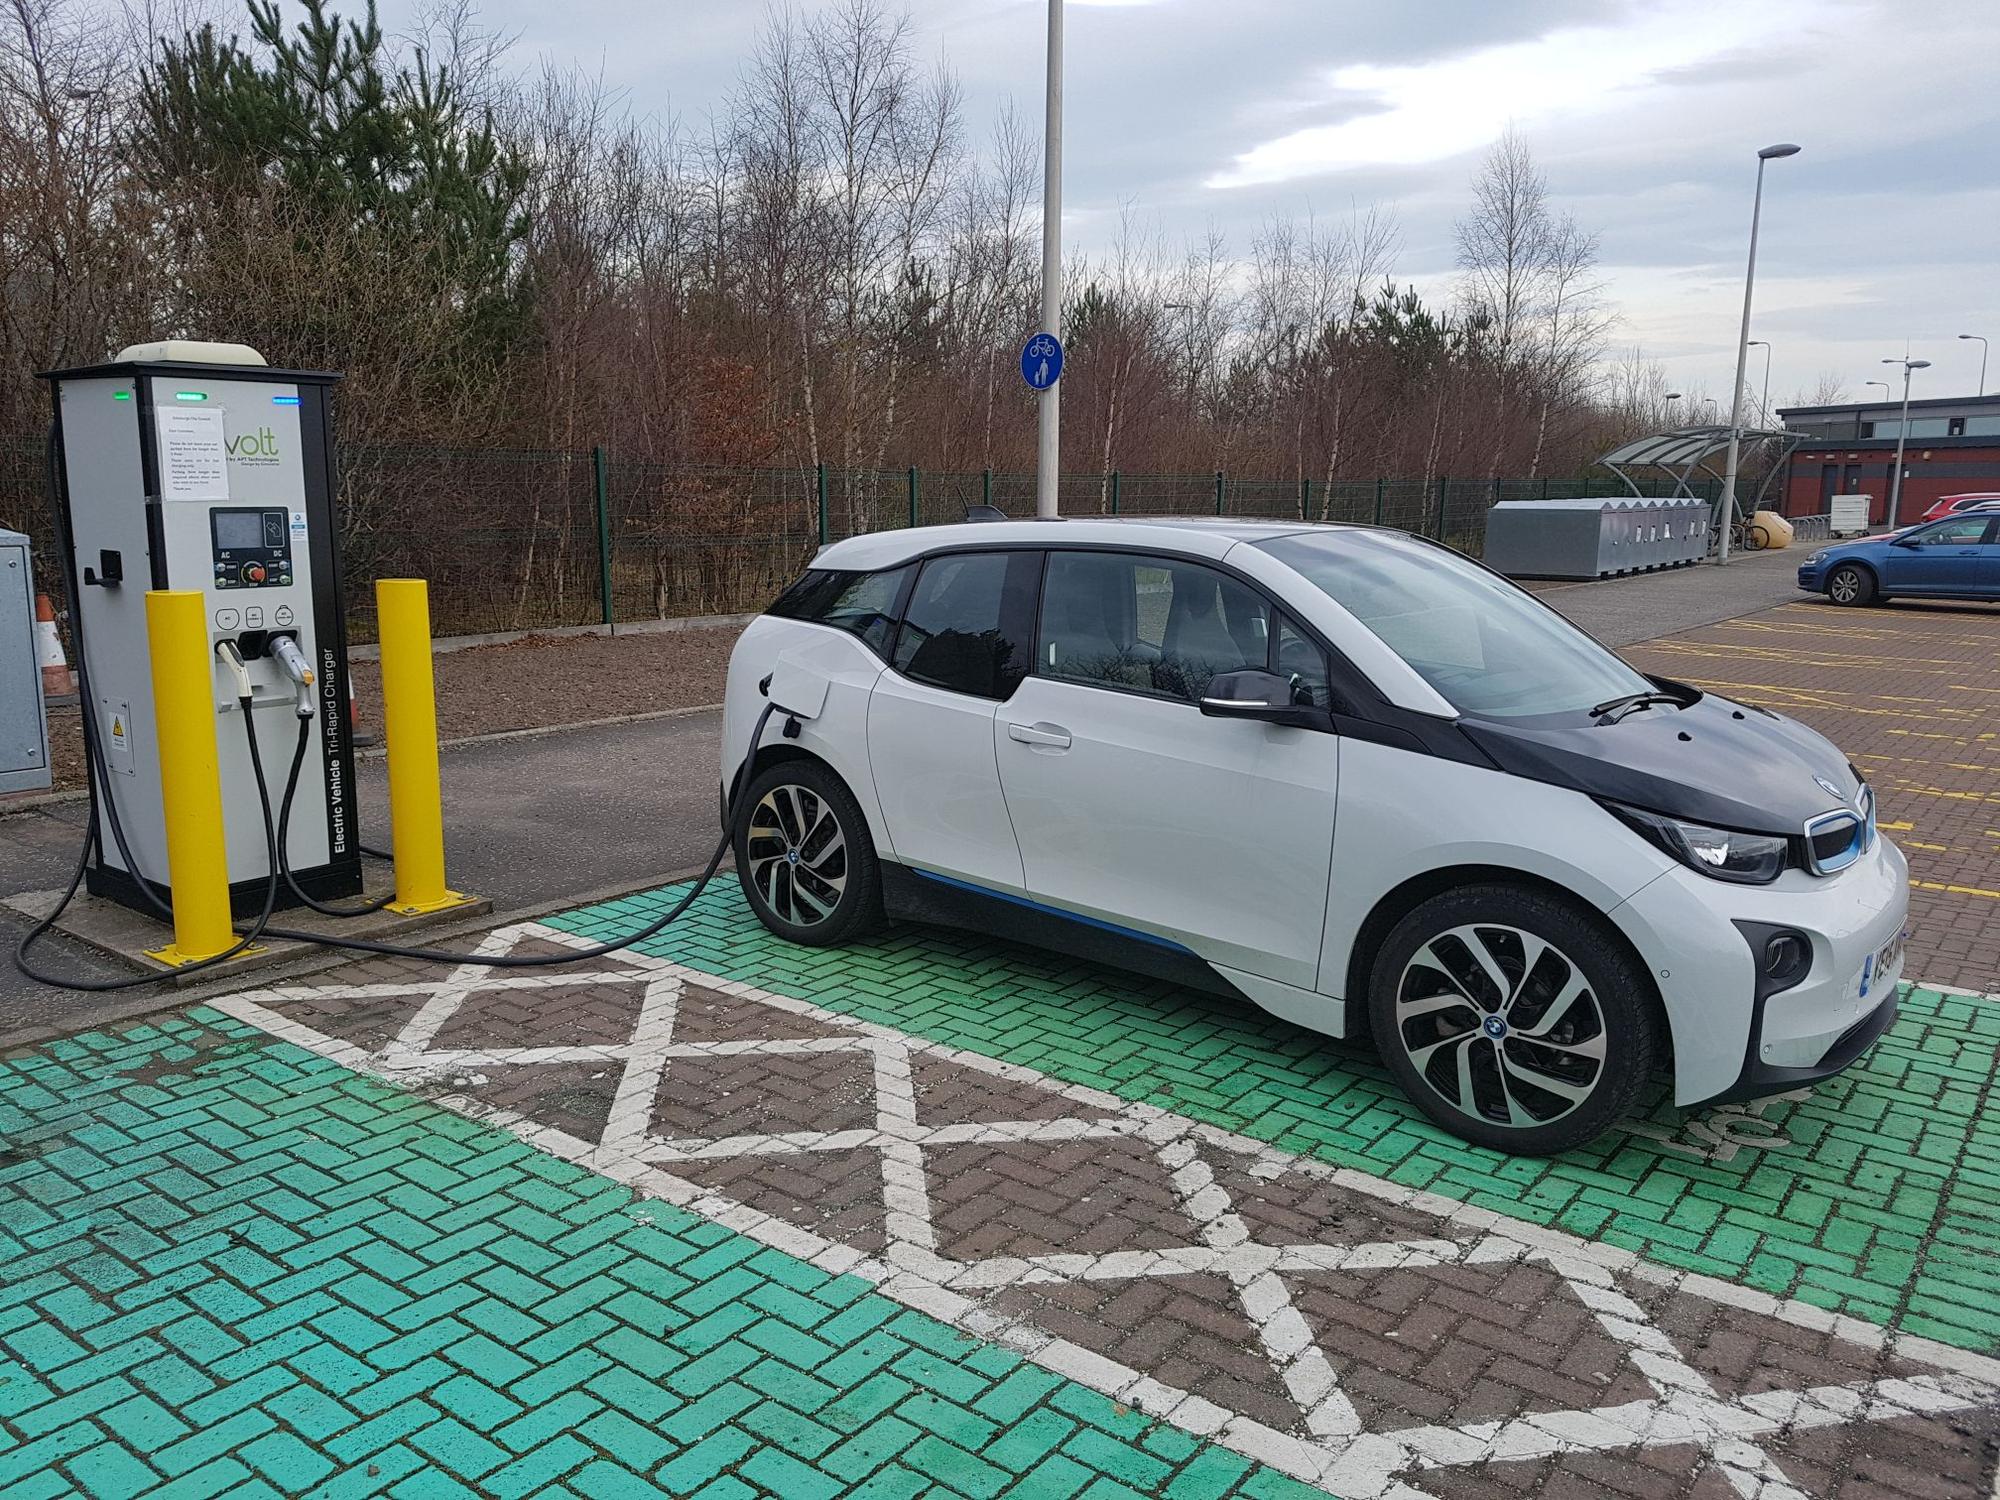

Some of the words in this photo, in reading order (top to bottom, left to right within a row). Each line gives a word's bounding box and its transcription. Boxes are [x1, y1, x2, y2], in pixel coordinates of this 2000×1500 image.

[221, 551, 231, 559] AC
[324, 648, 337, 698] Charger
[325, 700, 341, 756] Tri-Rapid
[327, 759, 343, 806] Vehicle
[332, 806, 346, 854] Electric
